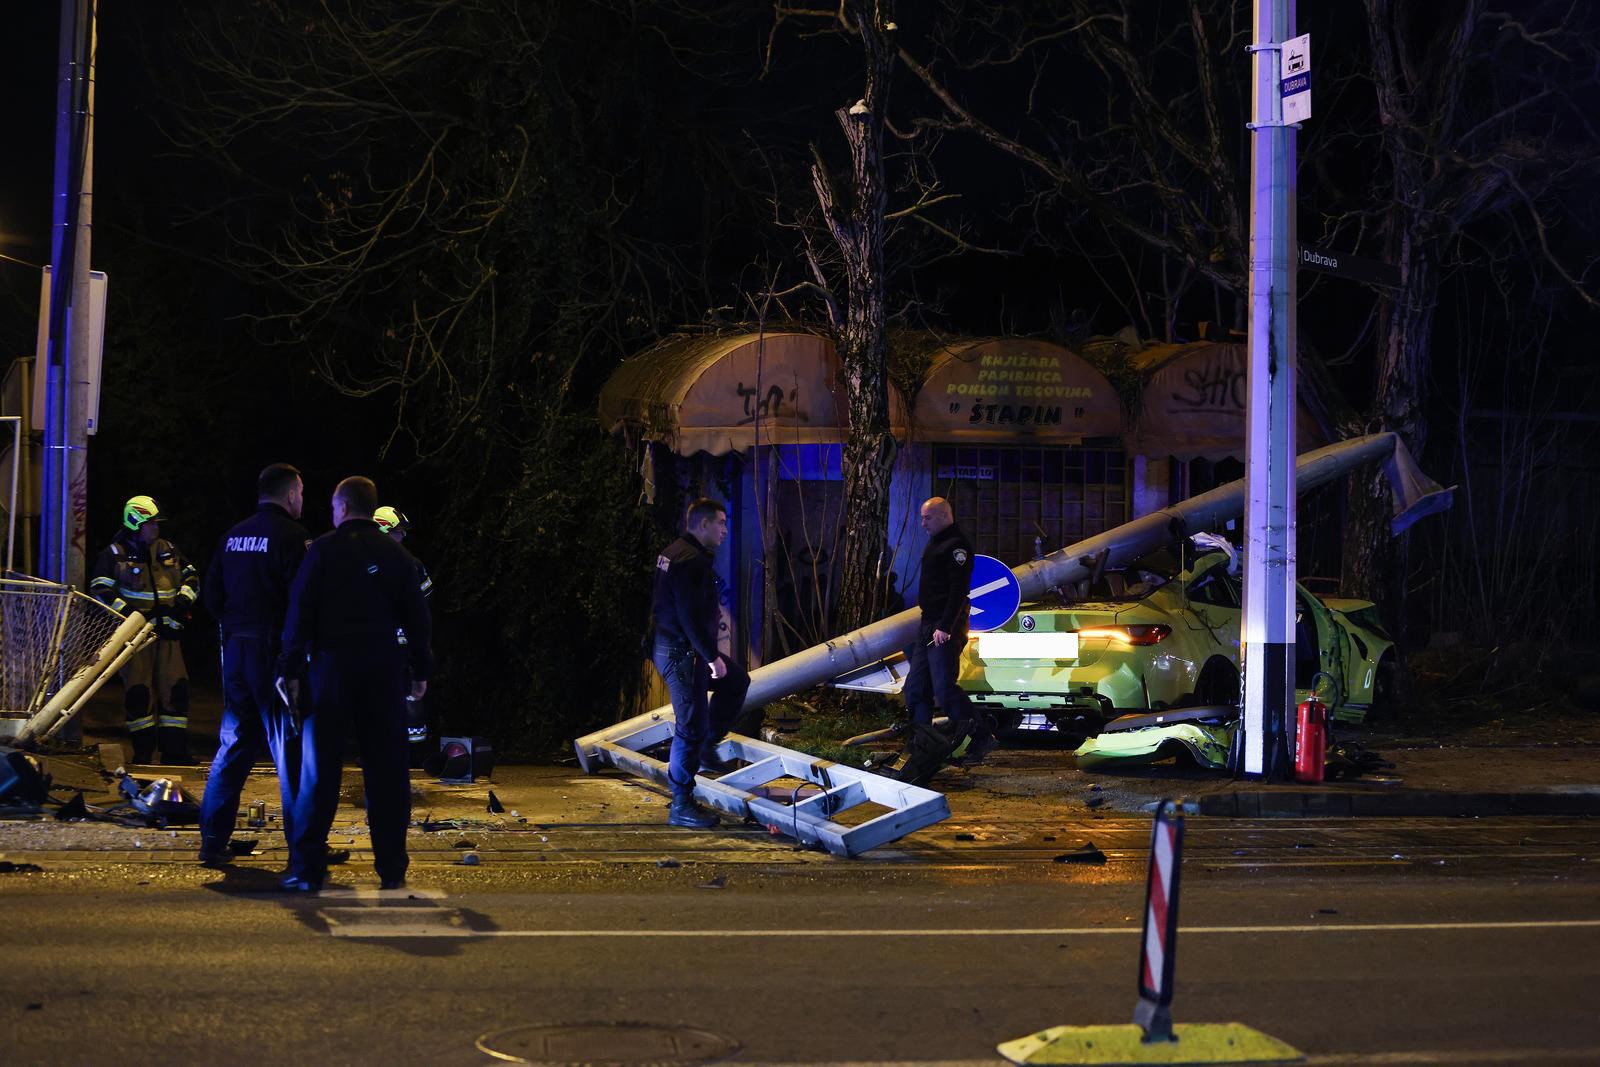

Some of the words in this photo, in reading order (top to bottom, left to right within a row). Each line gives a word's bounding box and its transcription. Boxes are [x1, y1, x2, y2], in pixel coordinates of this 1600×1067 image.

[1284, 76, 1307, 93] DUBRAVA
[1304, 250, 1338, 269] Dubrava
[980, 352, 1061, 368] KNJIŽARA
[978, 370, 1063, 384] PAPIRNICA
[946, 383, 1010, 396] POKLON
[1015, 385, 1093, 399] TRGOVINA
[225, 536, 269, 553] POLICIJA
